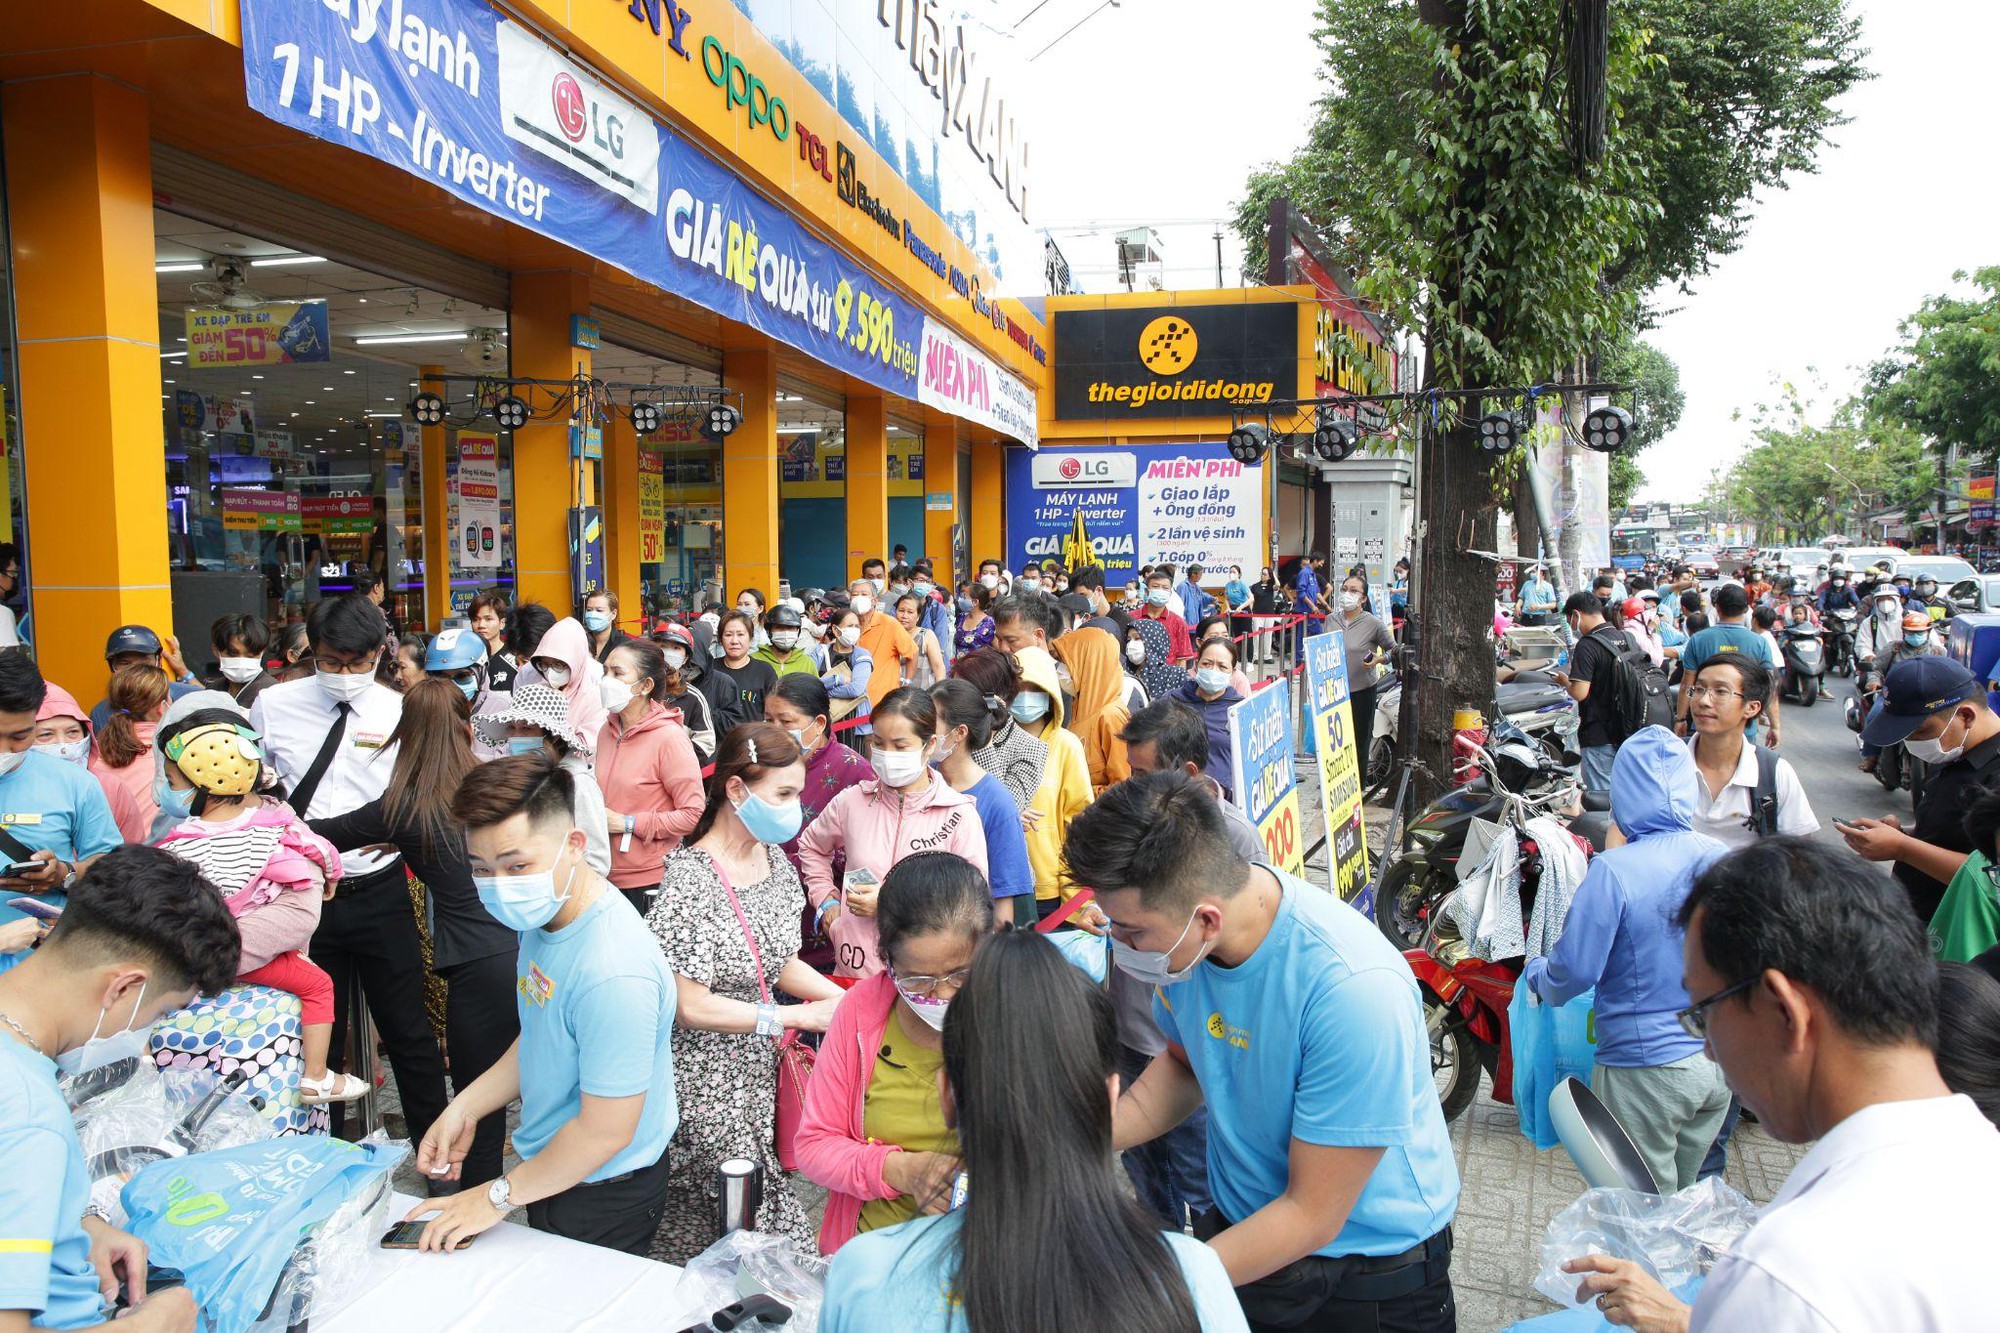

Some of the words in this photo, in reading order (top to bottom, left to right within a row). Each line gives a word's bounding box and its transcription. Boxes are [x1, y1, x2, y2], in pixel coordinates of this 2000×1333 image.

[273, 42, 300, 108] 1
[309, 55, 382, 136] HP
[412, 110, 551, 222] Inverter
[591, 102, 625, 160] LG
[796, 121, 832, 182] TCL
[857, 180, 900, 241] Electrolux
[904, 218, 947, 280] Panasonic
[195, 316, 207, 326] XE
[211, 315, 231, 327] ĐẠP
[257, 312, 271, 323] EM
[834, 278, 893, 364] 9.590
[893, 338, 917, 380] triệu
[192, 328, 223, 345] GIẢM
[200, 344, 224, 363] ĐẾN
[1088, 380, 1274, 408] thegioididong
[1085, 461, 1109, 475] LG
[1046, 491, 1077, 505] MÁY
[1078, 493, 1118, 508] LẠNH
[1161, 486, 1199, 500] Giao
[1203, 484, 1230, 502] lắp
[1034, 509, 1041, 520] 1
[1043, 508, 1062, 520] HP
[1165, 501, 1195, 518] Ống
[1198, 502, 1236, 517] đồng
[1025, 534, 1060, 555] GIÁ
[1091, 533, 1135, 555] QUÁ
[1157, 528, 1167, 540] 2
[1169, 526, 1191, 539] lần
[1193, 526, 1210, 541] vệ
[1213, 526, 1245, 539] sinh
[1107, 559, 1132, 570] triệu
[1158, 551, 1195, 563] T.Góp
[1327, 712, 1343, 752] 50
[1344, 743, 1354, 770] TV
[1329, 772, 1358, 813] SAMSUNG
[910, 811, 962, 851] Christian
[1339, 859, 1353, 898] 990
[840, 943, 865, 970] CD
